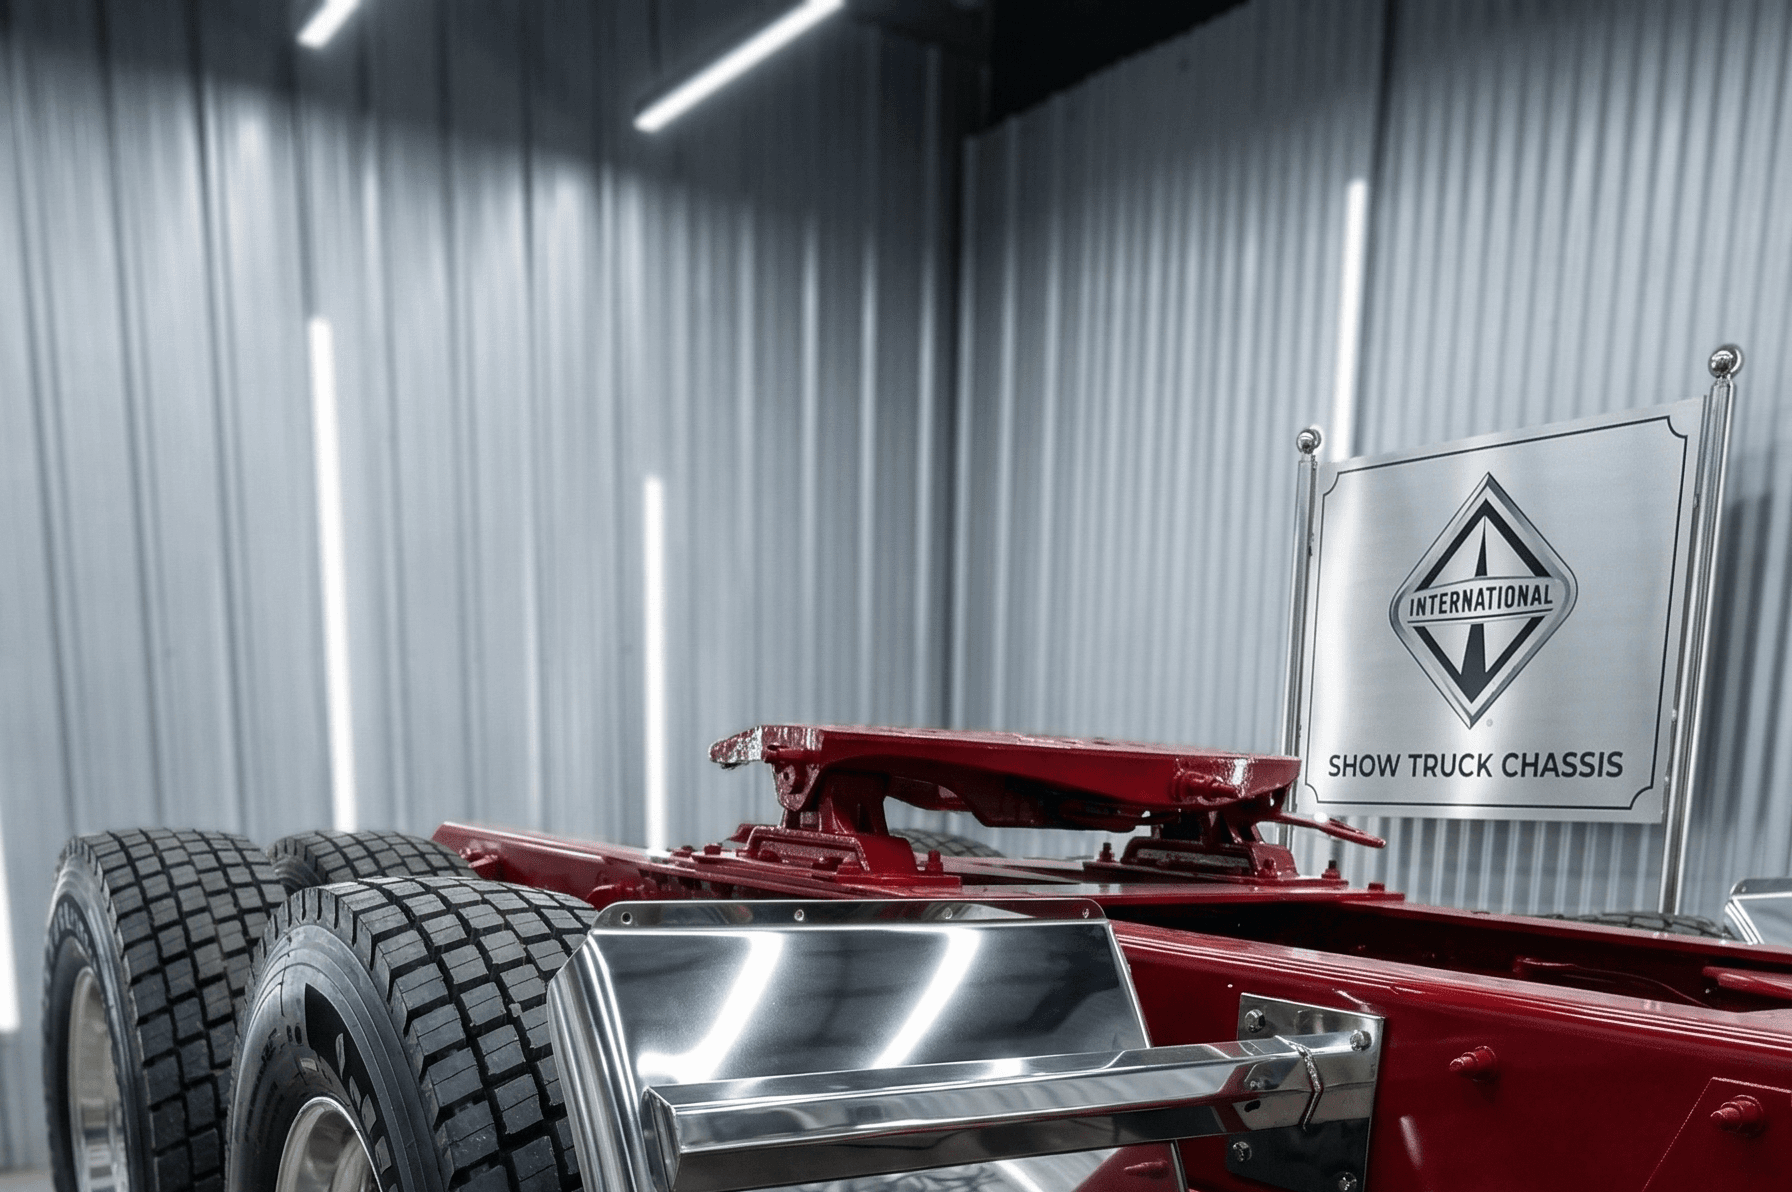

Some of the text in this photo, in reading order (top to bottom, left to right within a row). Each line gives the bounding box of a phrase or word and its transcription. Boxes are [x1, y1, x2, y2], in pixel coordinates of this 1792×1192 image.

[1409, 584, 1553, 617] INTERNATIONAL
[1328, 751, 1624, 778] SHOW TRUCK CHASSIS
